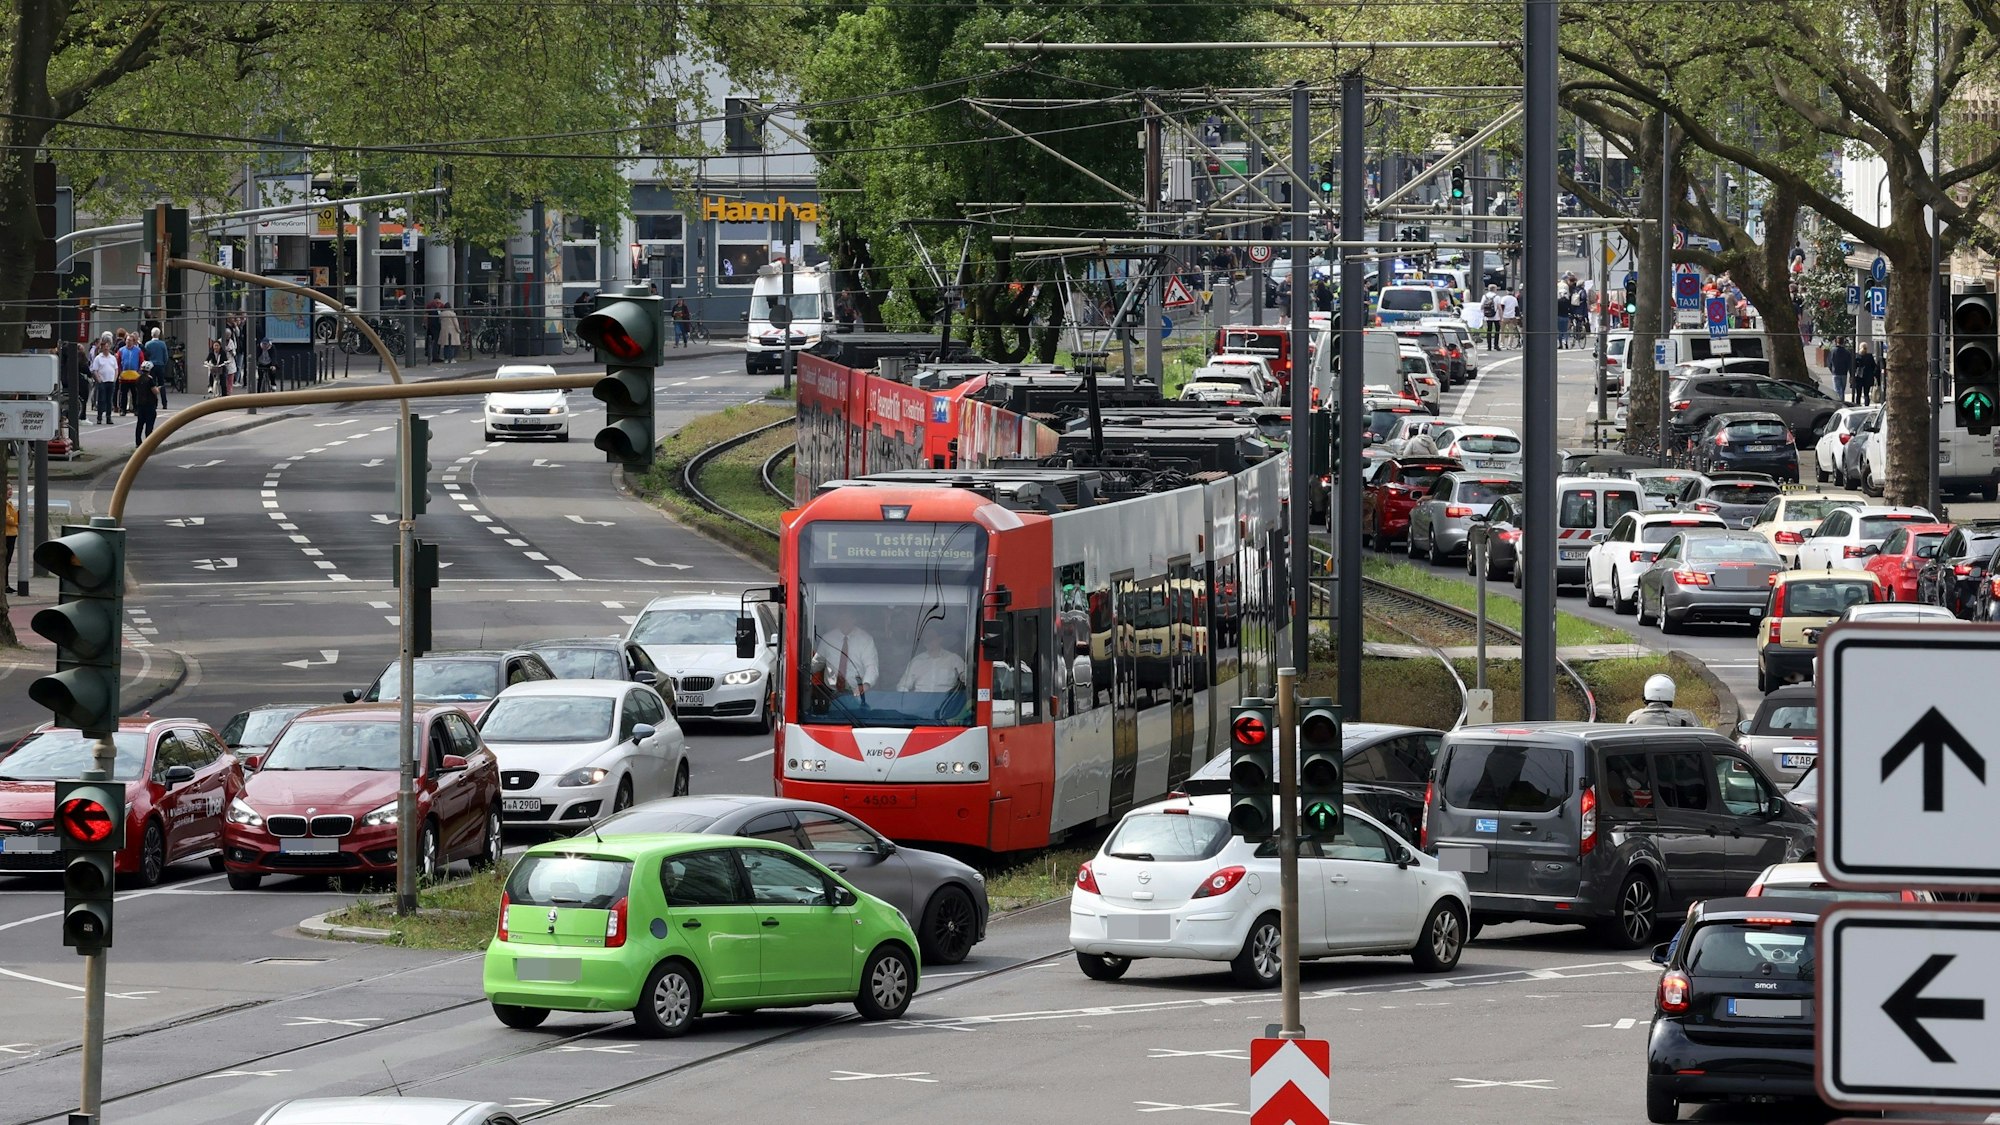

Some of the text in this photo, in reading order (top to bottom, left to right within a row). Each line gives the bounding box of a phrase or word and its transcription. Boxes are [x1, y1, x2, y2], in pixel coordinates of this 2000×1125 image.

[271, 220, 306, 228] MoneyGram
[1253, 247, 1266, 257] 30
[1848, 287, 1857, 302] P
[1678, 298, 1698, 307] TAXI
[1873, 291, 1883, 313] P
[1710, 325, 1727, 335] TAXI
[827, 532, 946, 560] E Testfahrt
[847, 547, 974, 559] Bitte nicht einsteigen
[685, 695, 703, 703] 7000
[866, 749, 883, 757] KVB
[1787, 756, 1794, 765] K
[519, 800, 539, 810] 2900
[863, 795, 897, 805] 4503
[1754, 982, 1777, 990] smart
